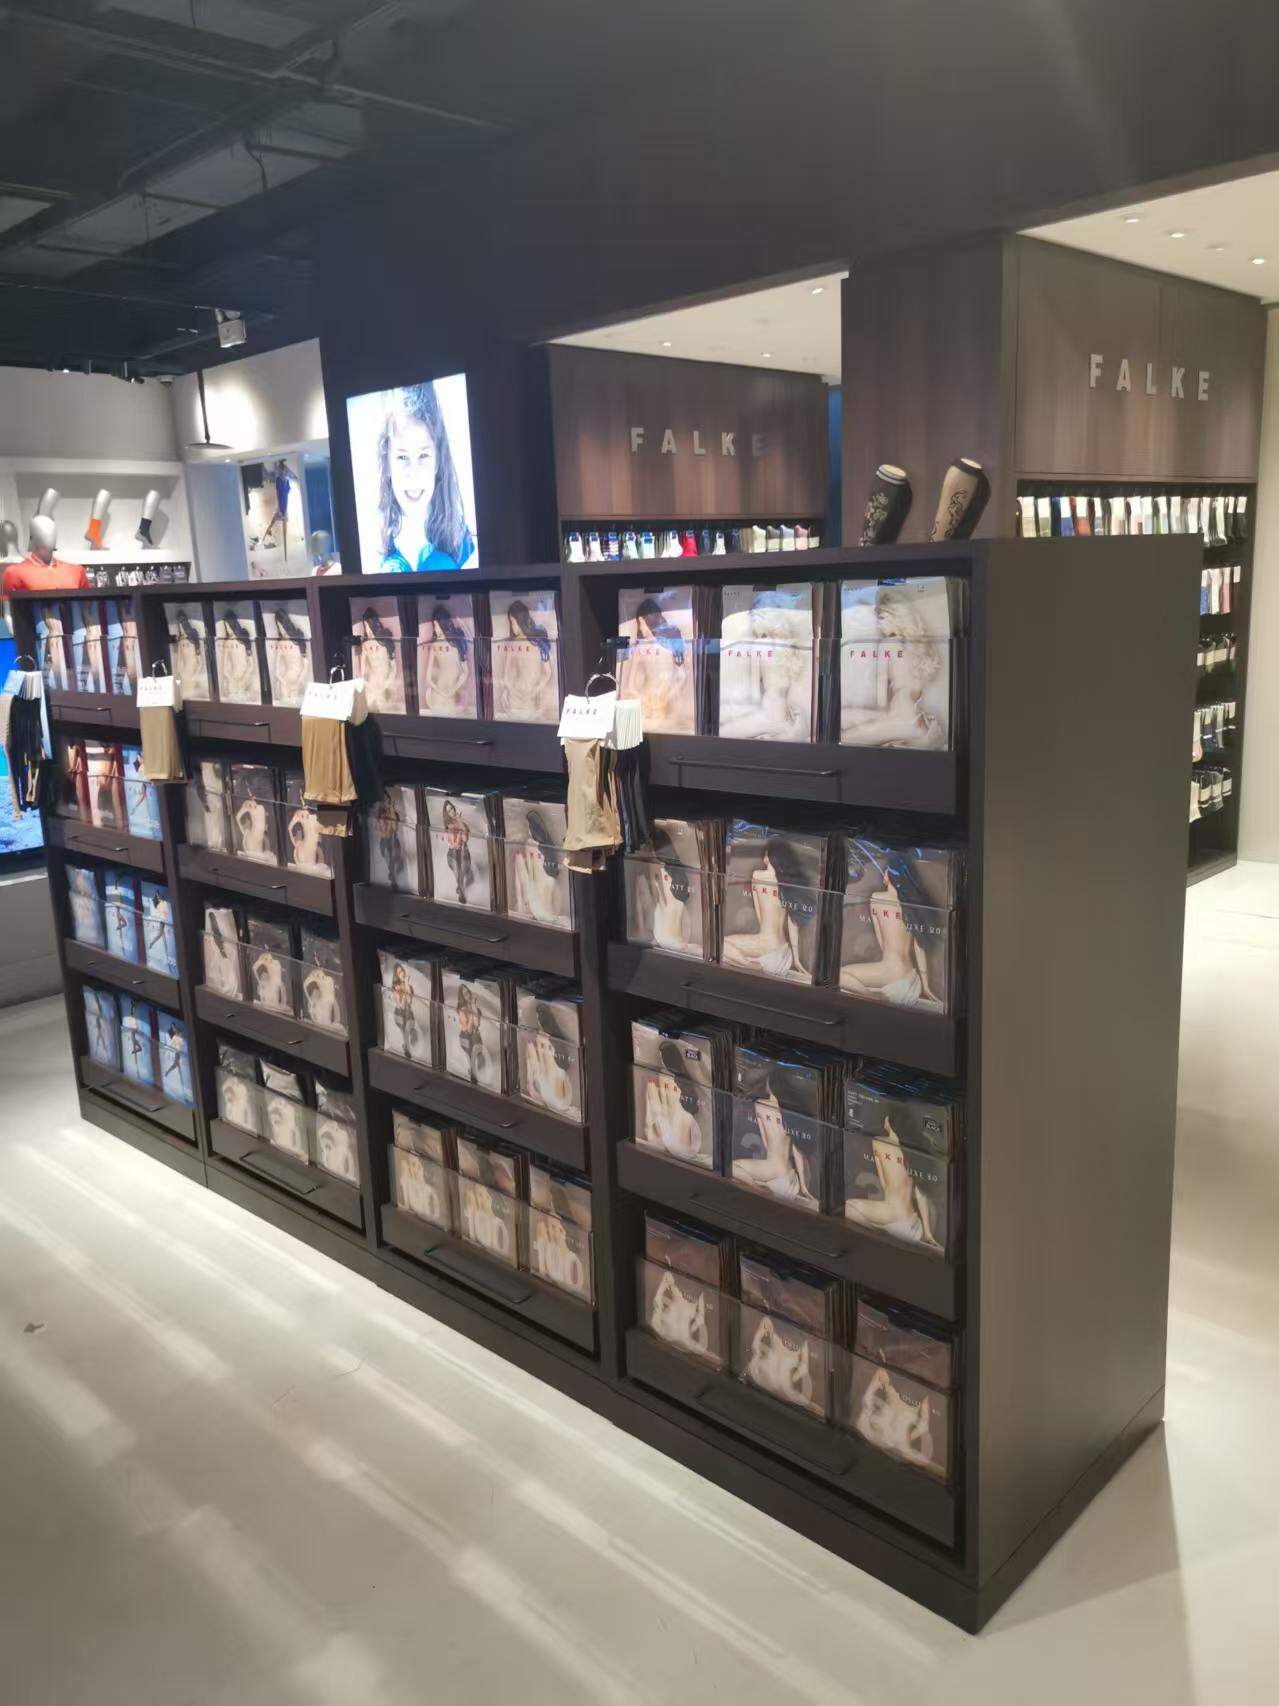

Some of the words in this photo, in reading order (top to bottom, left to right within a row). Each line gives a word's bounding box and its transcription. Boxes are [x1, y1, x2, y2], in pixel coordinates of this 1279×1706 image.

[1089, 353, 1209, 401] FALKE
[630, 427, 767, 457] FALKE
[728, 649, 774, 658] FALKE
[850, 649, 904, 659] FALKE
